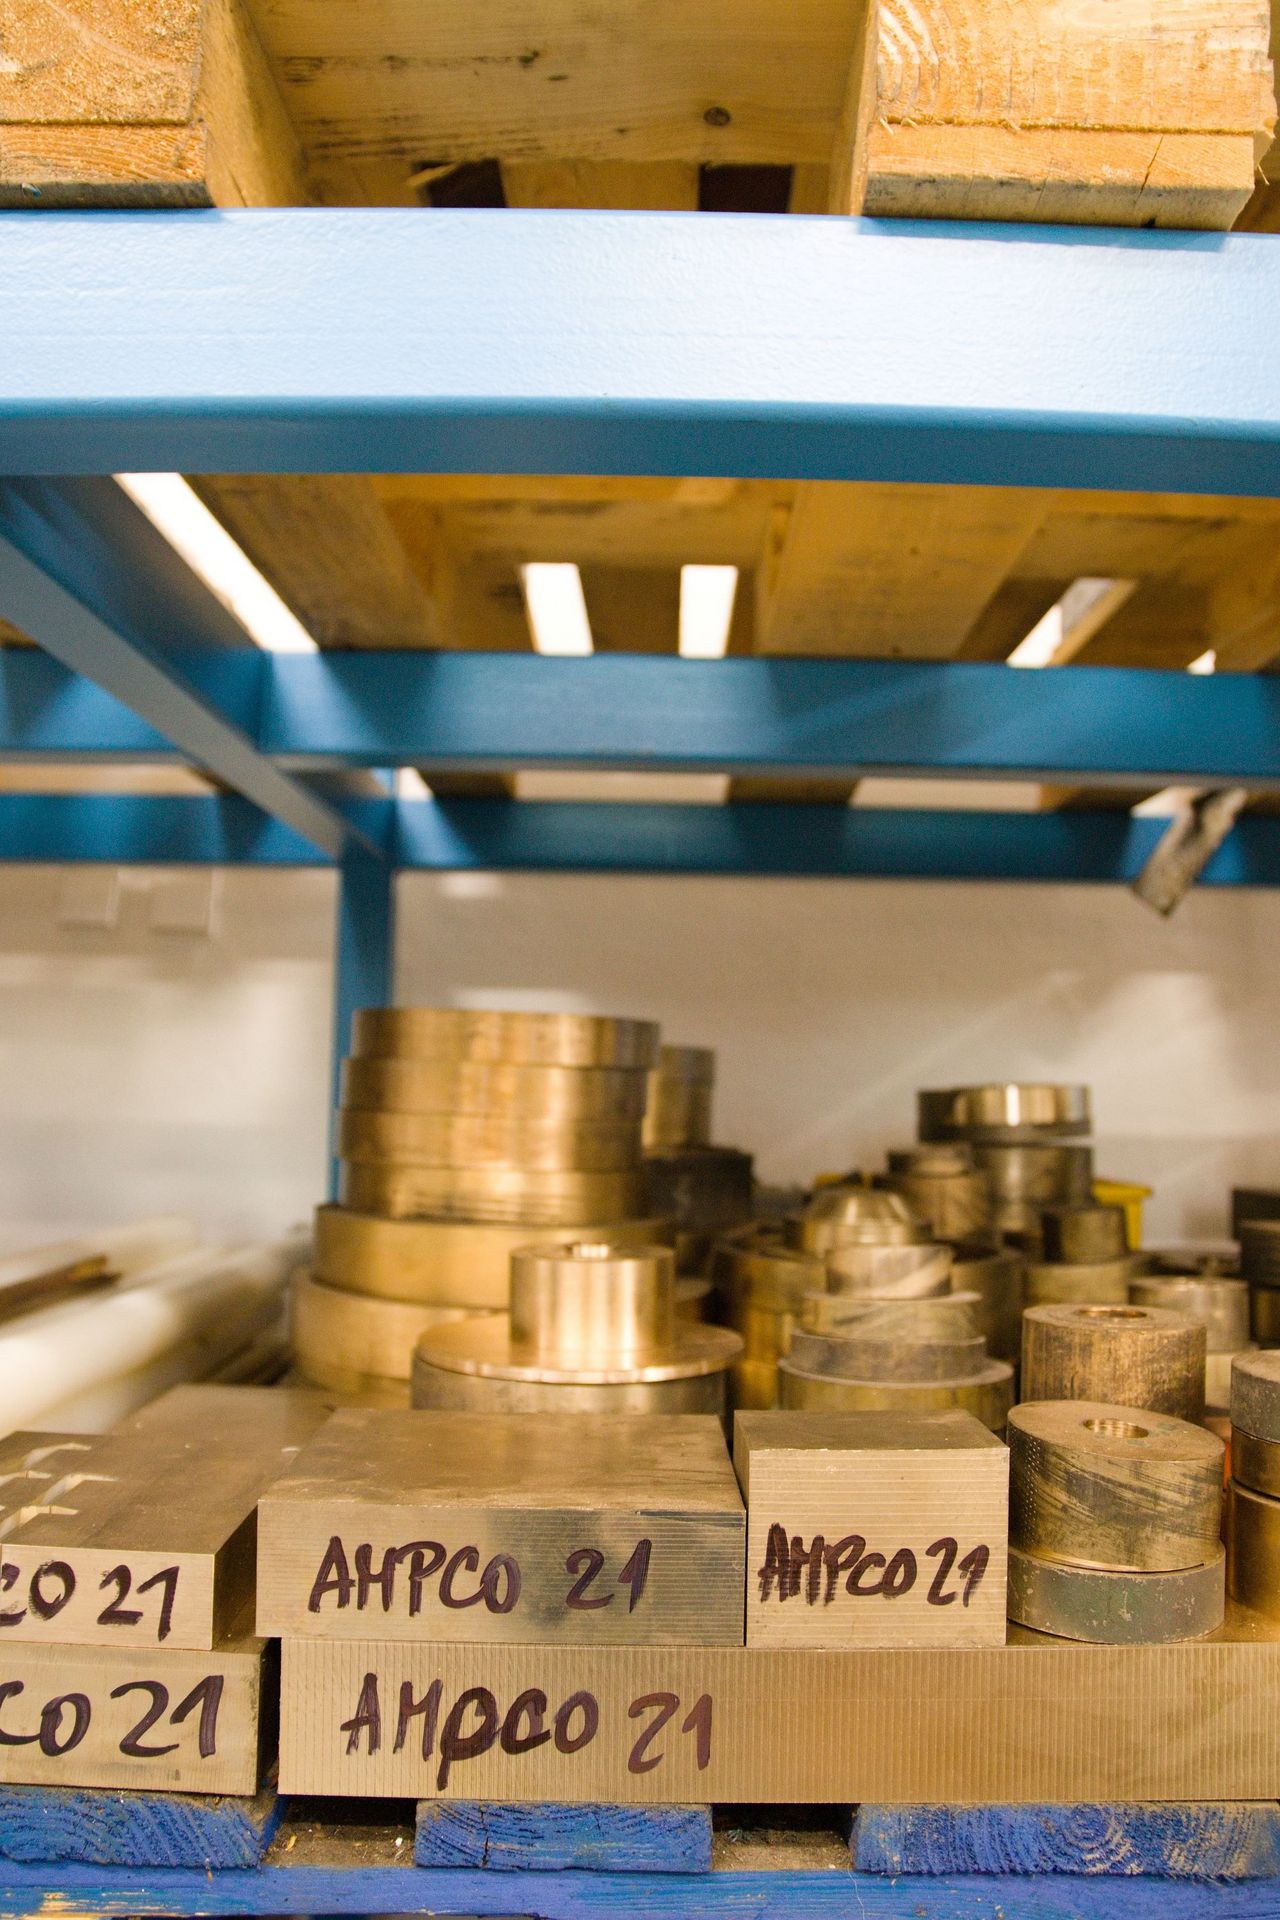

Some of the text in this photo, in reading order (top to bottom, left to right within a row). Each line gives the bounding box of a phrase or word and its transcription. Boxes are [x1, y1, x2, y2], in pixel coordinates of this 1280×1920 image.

[97, 1564, 181, 1641] 21
[566, 1538, 653, 1614] 21
[925, 1536, 991, 1607] 21
[110, 1675, 225, 1758] 21
[627, 1692, 713, 1774] 21
